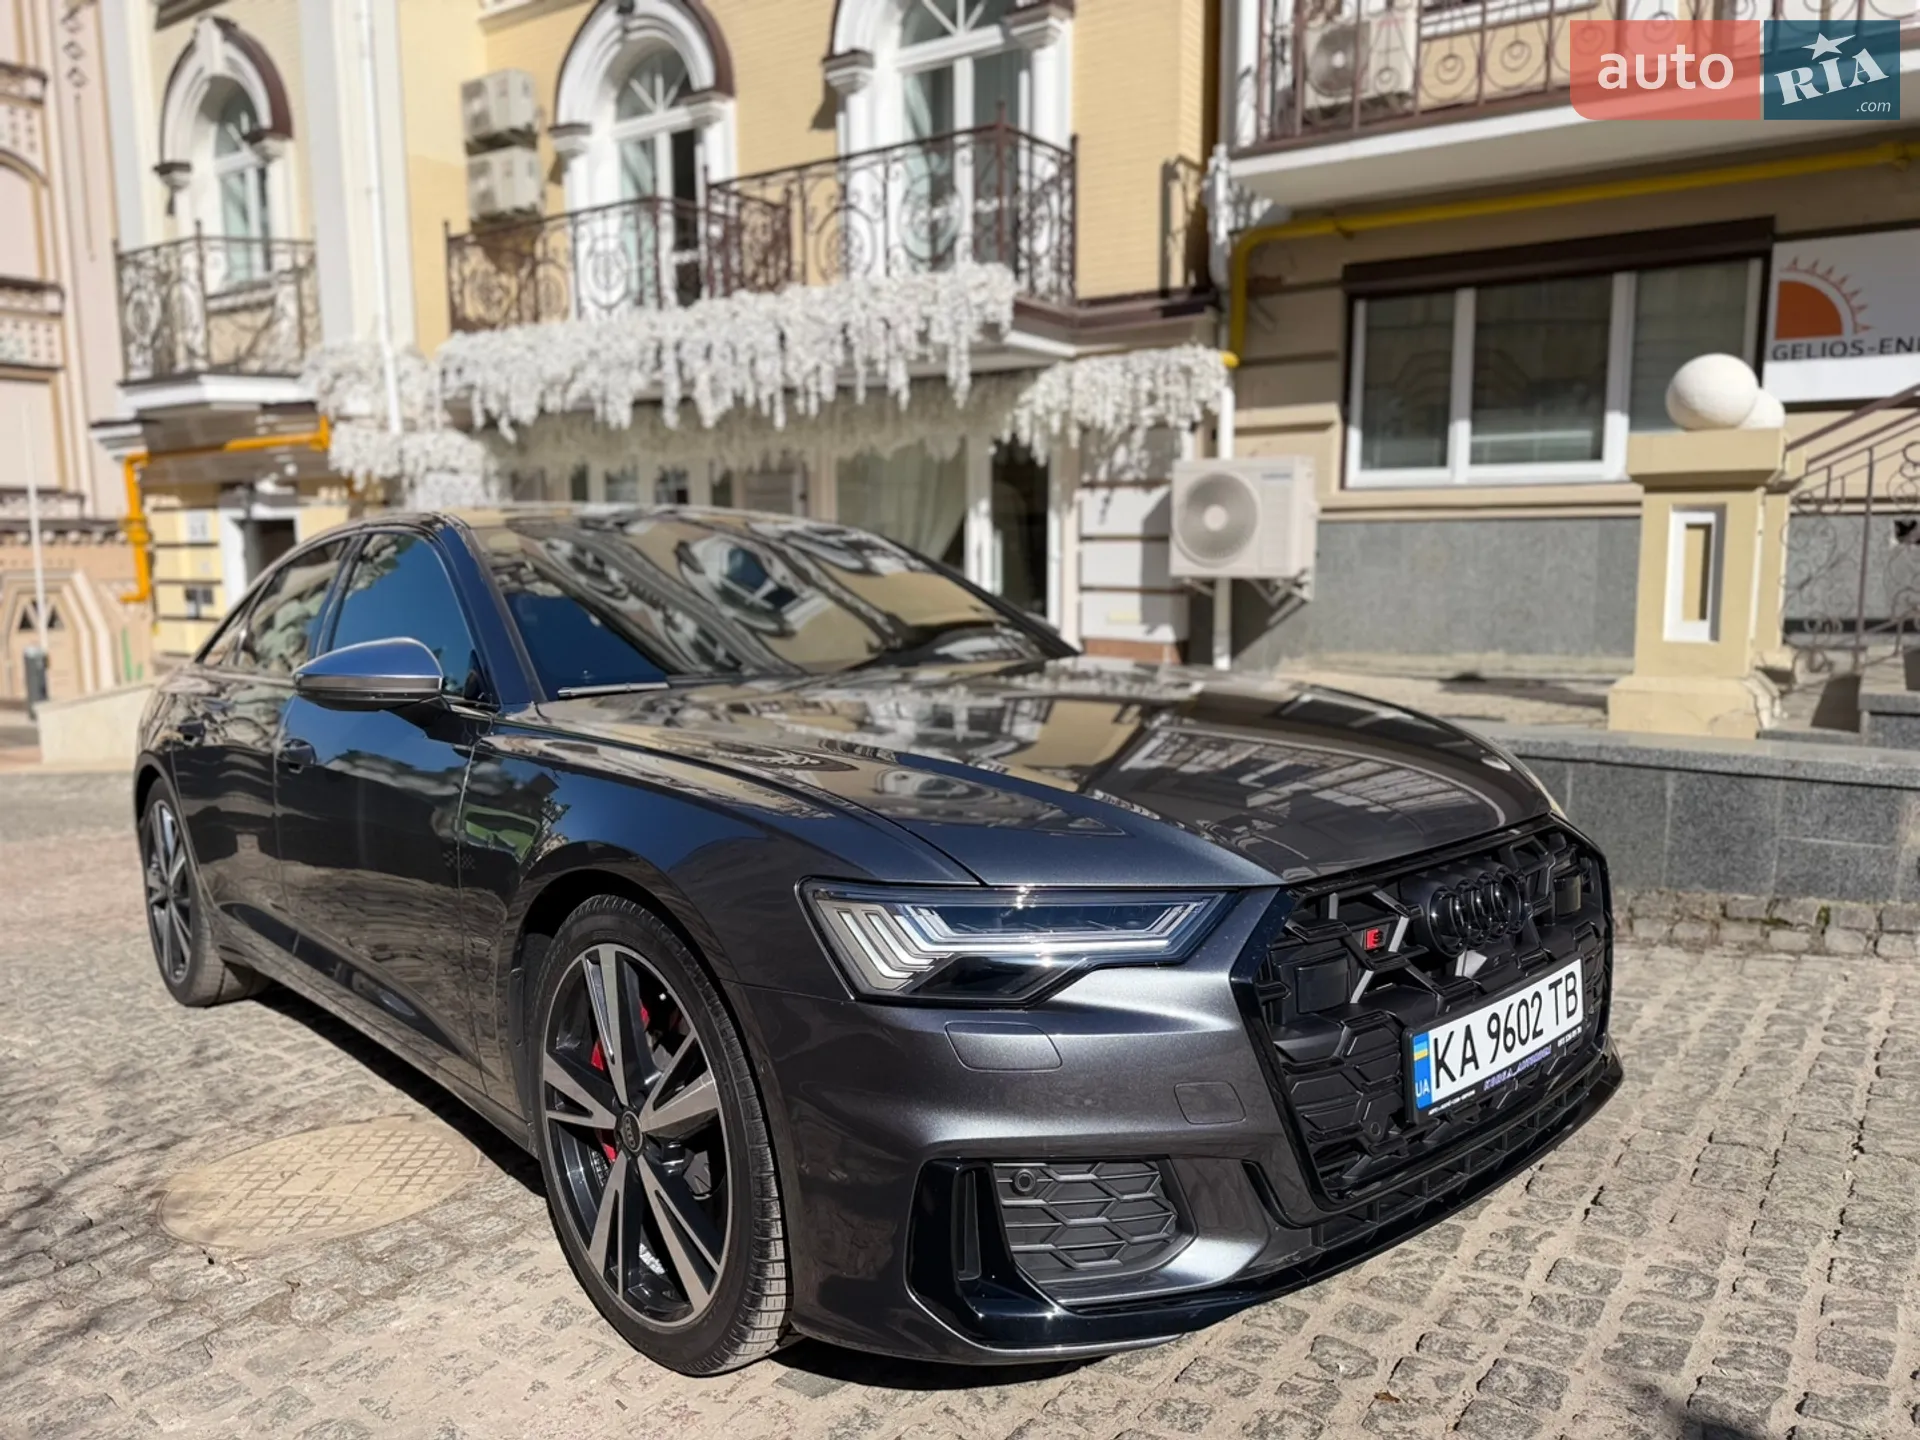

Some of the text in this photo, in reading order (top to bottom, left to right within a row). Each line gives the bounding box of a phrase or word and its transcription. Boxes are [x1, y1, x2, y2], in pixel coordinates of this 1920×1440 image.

[1433, 1023, 1480, 1089] KA
[1486, 991, 1544, 1064] 9602
[1549, 970, 1579, 1027] TB
[1415, 1078, 1431, 1098] UA
